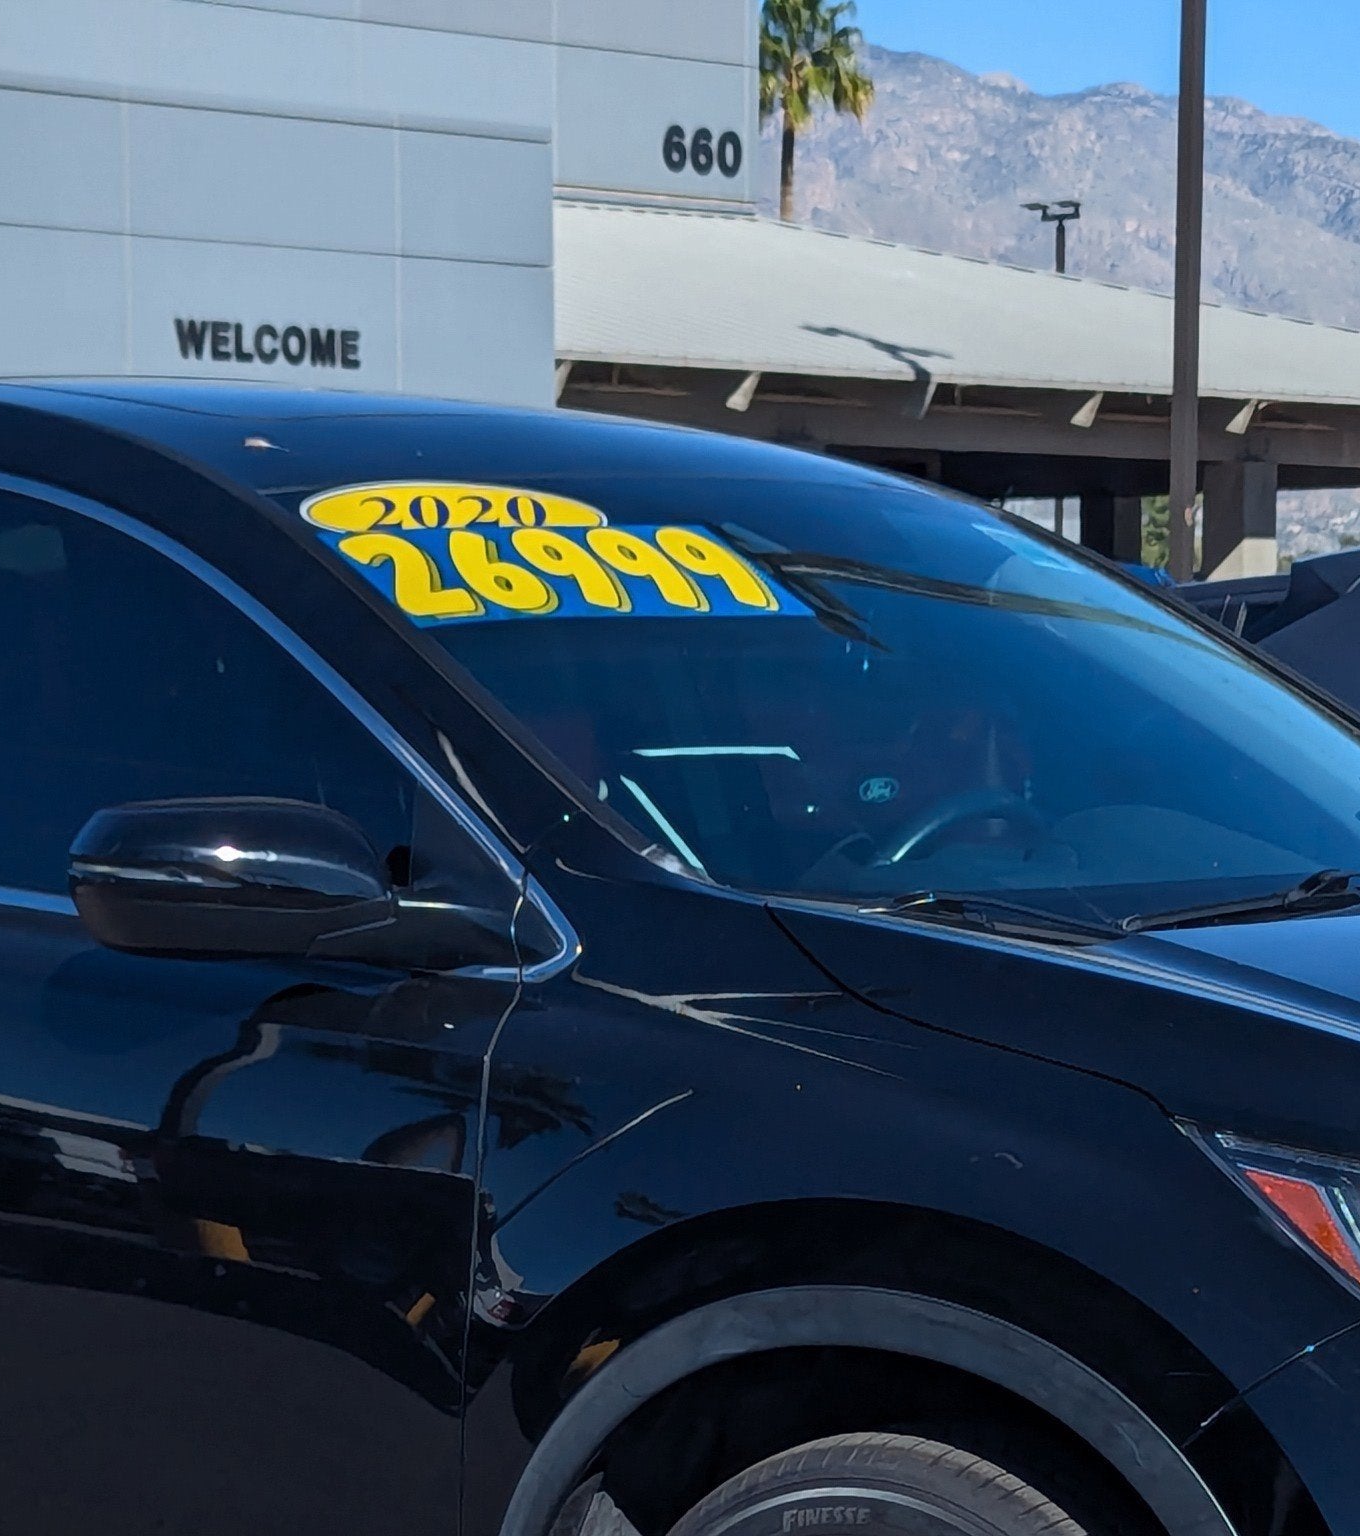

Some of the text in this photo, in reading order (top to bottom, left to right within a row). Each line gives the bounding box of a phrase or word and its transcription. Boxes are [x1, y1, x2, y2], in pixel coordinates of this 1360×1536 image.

[662, 124, 742, 177] 660
[175, 317, 361, 369] WELCOME
[359, 495, 547, 530] 2020
[338, 527, 780, 618] 26999
[782, 1505, 873, 1533] FINESSE
